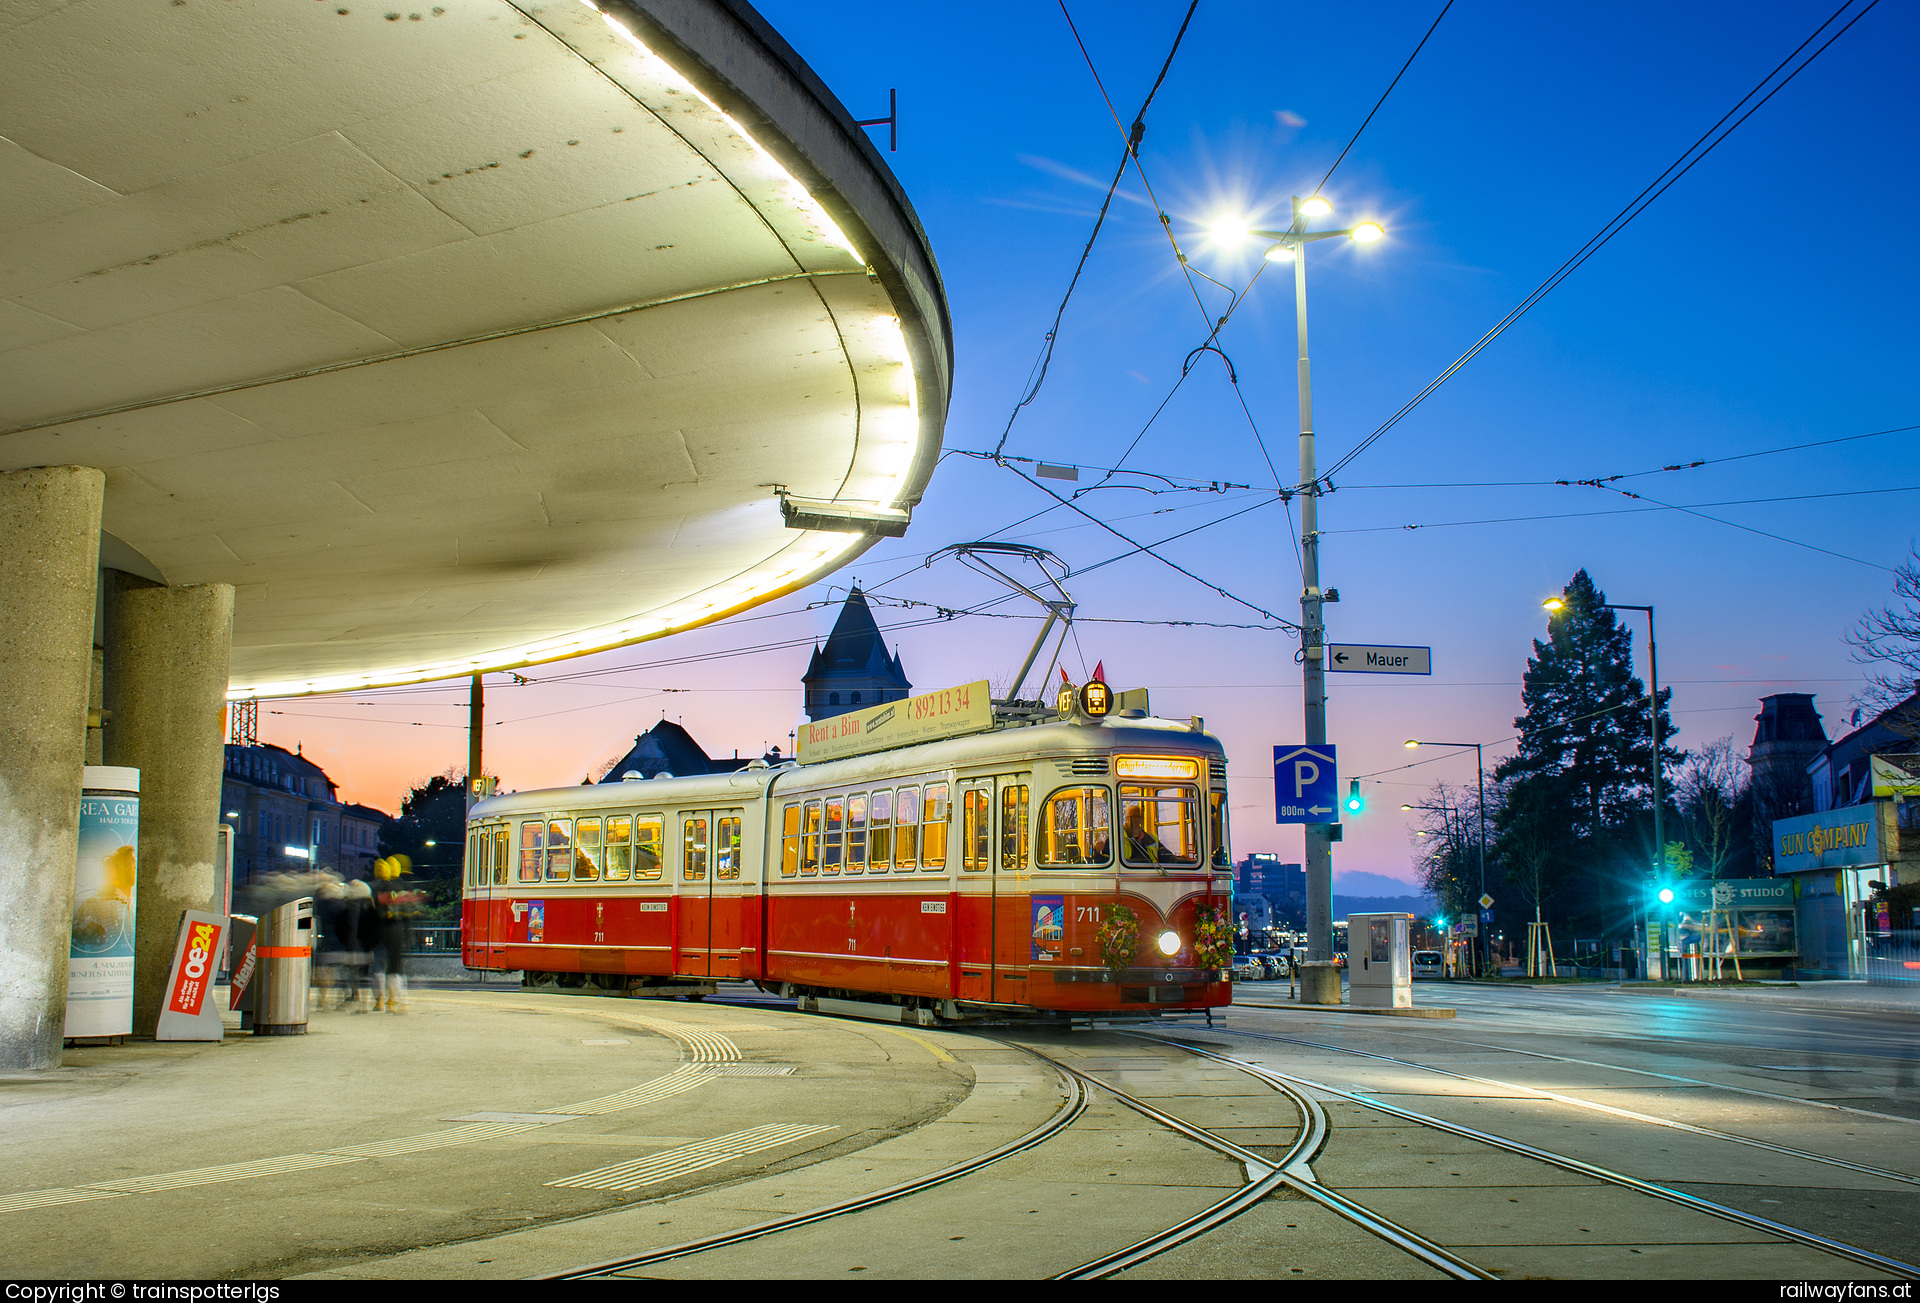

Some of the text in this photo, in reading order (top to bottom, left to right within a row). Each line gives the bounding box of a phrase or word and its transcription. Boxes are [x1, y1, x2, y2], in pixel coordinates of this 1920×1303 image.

[1366, 651, 1409, 667] Mauer
[915, 686, 970, 720] 892 13 34
[1058, 690, 1072, 712] VEF
[809, 715, 860, 745] Rent a Bim
[1295, 761, 1320, 798] P
[1281, 805, 1305, 816] 800m
[1781, 832, 1804, 857] SUN
[1740, 887, 1785, 897] STUDIO
[1076, 906, 1100, 923] 711
[594, 932, 604, 943] 711
[848, 938, 856, 952] 711
[185, 924, 214, 978] oe24
[232, 944, 256, 989] Heute
